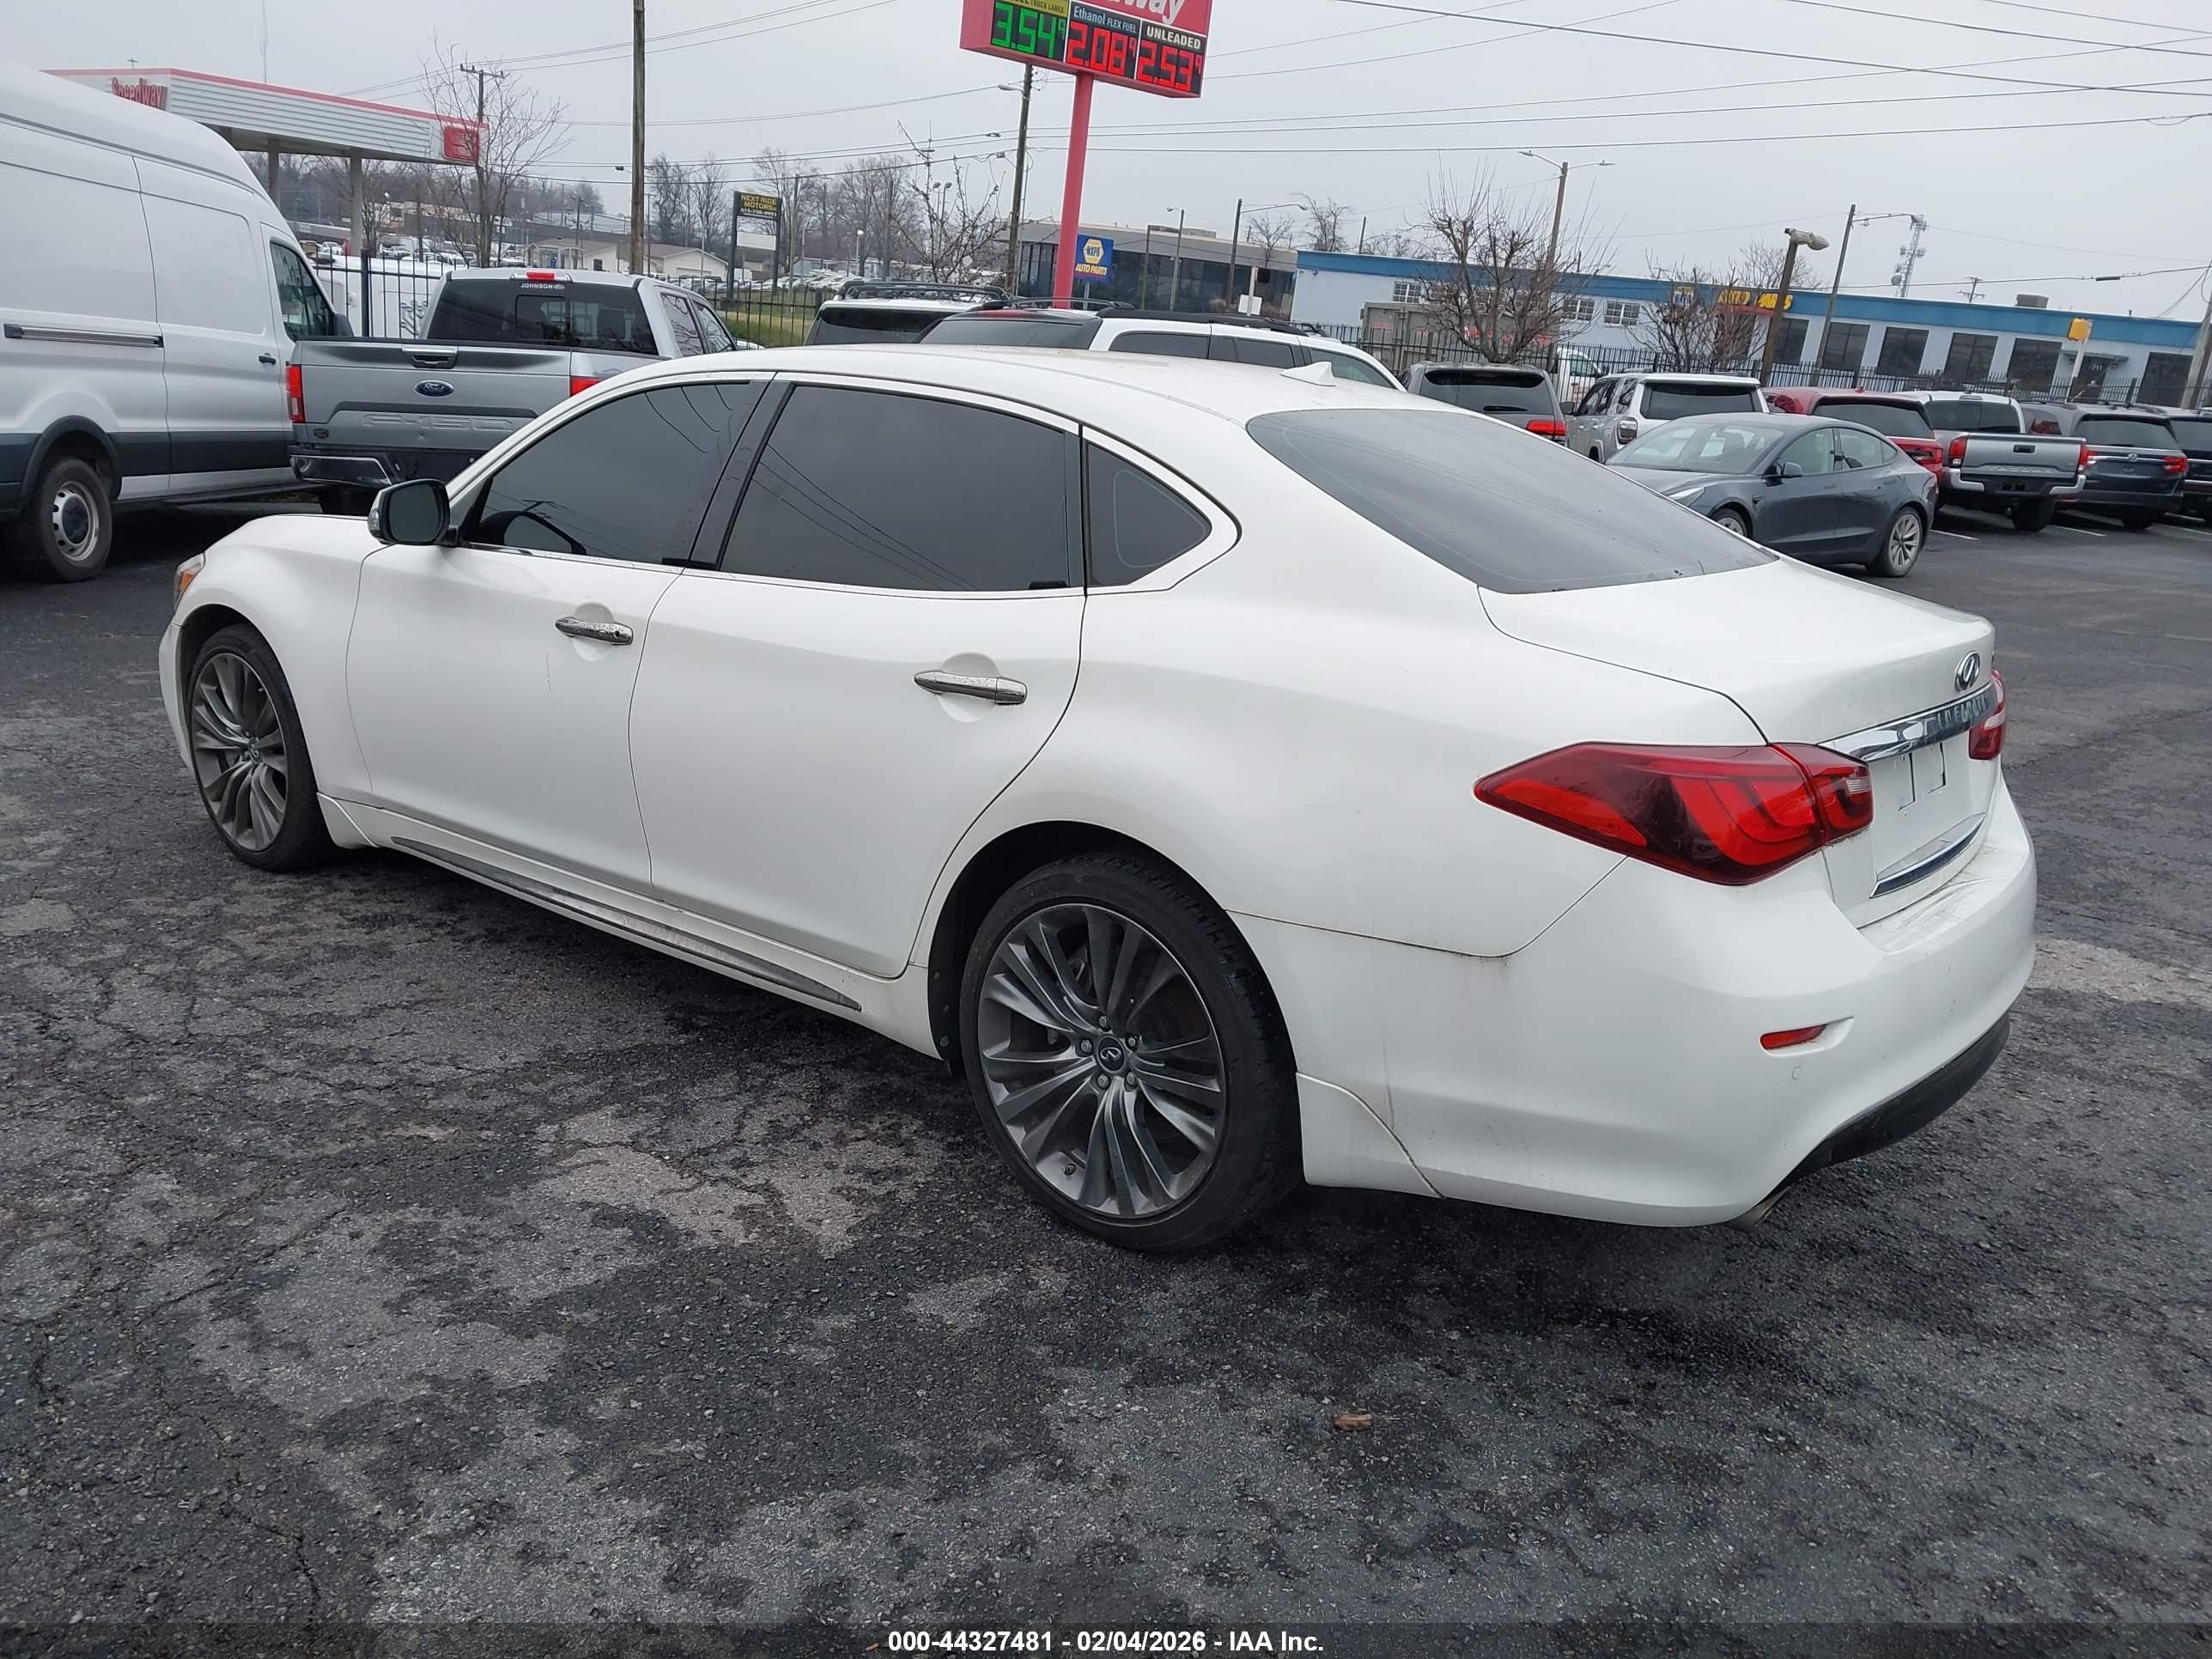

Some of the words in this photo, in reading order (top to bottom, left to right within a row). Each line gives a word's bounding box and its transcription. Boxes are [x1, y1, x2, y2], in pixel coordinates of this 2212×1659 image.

[1073, 5, 1106, 25] Ethanol
[1107, 17, 1122, 30] FLEX
[1122, 21, 1138, 33] FUEL
[1146, 25, 1201, 50] UNLEADED
[740, 194, 760, 203] NEXT
[760, 197, 777, 205] RIDE
[744, 201, 774, 210] MOTORS
[1075, 263, 1091, 273] AUTO
[1091, 265, 1109, 276] PARTS
[362, 413, 514, 433] F-150
